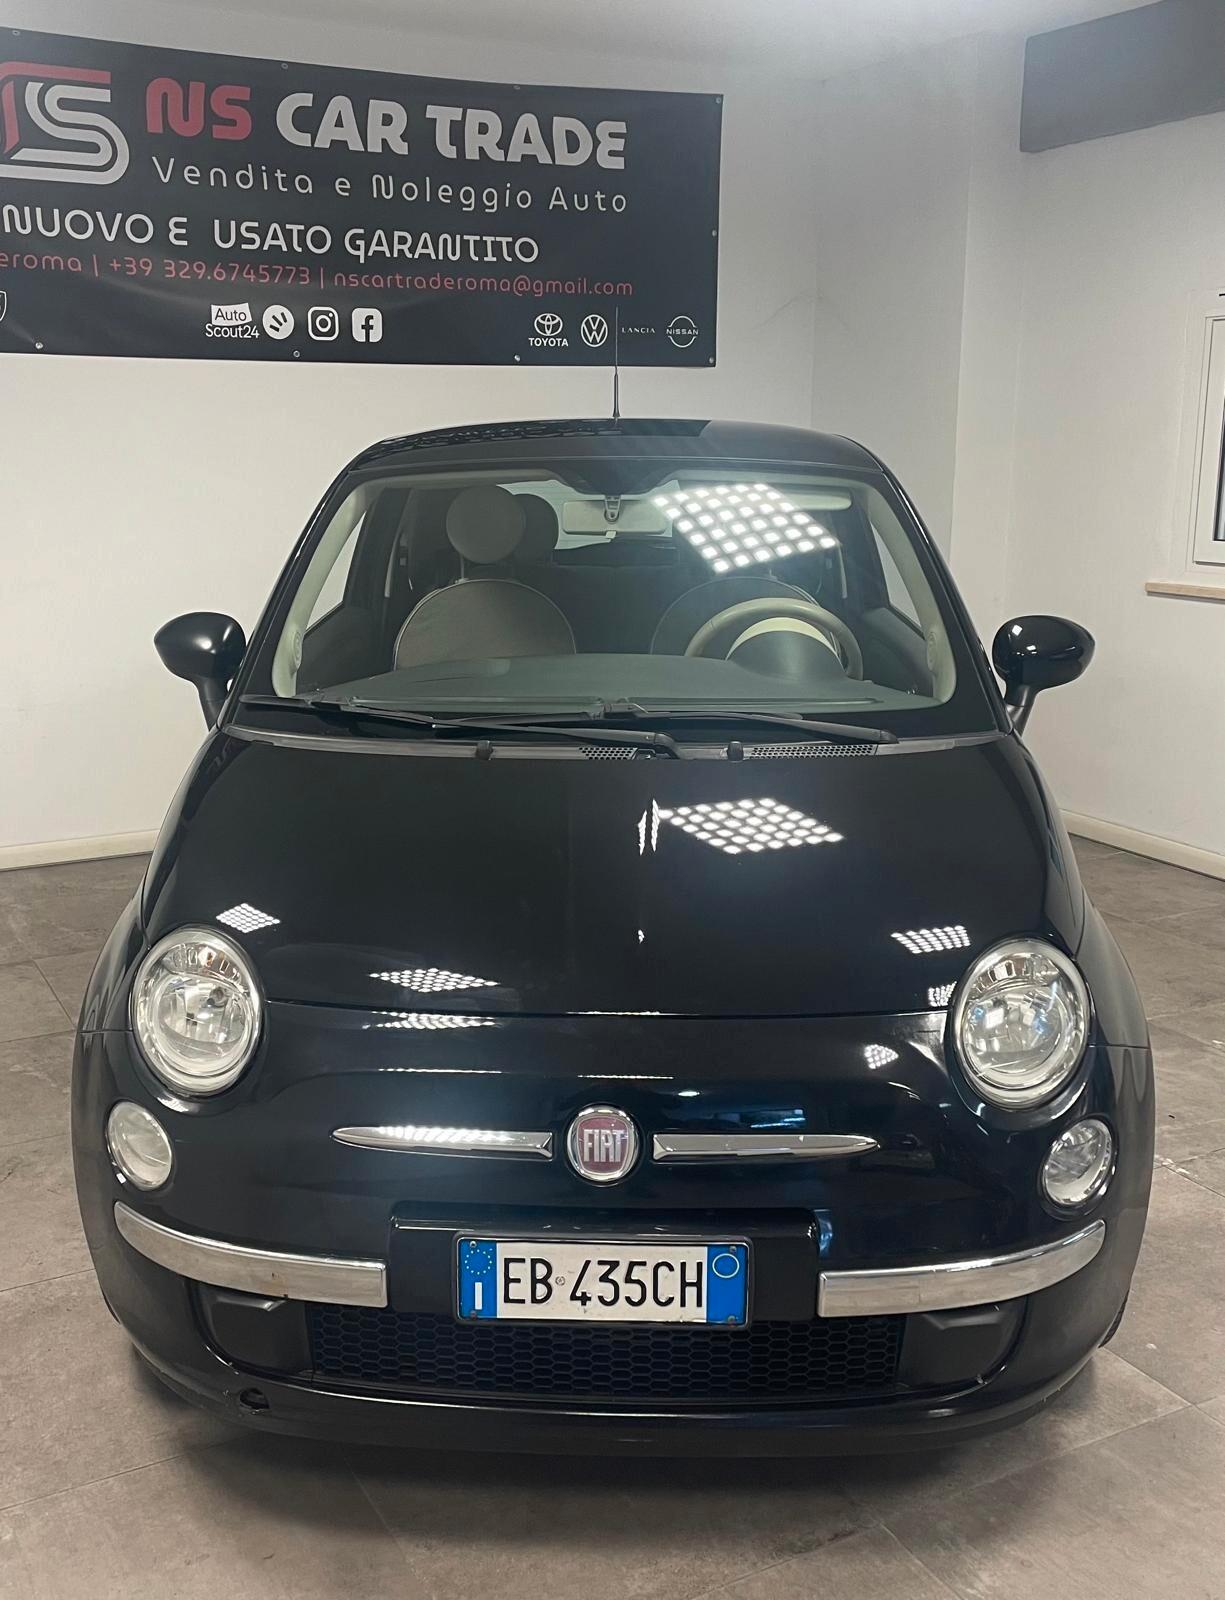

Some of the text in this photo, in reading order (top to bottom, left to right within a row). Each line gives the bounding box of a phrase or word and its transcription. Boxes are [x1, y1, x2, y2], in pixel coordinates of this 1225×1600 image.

[146, 77, 627, 169] NS CAR TRADE
[152, 156, 627, 213] Vendita e Noleggio Auto
[2, 204, 539, 264] NUOVO E USATO GARANTITO
[109, 256, 153, 277] +39
[163, 259, 311, 285] 329.6745773
[333, 271, 633, 297] nscartraderoma@gmail.com
[214, 307, 247, 323] Auto
[205, 322, 261, 340] Scout24
[528, 337, 569, 348] TOYOTA
[621, 326, 656, 334] LANCIA
[666, 327, 699, 336] NISSAN
[582, 1128, 624, 1163] FIAT
